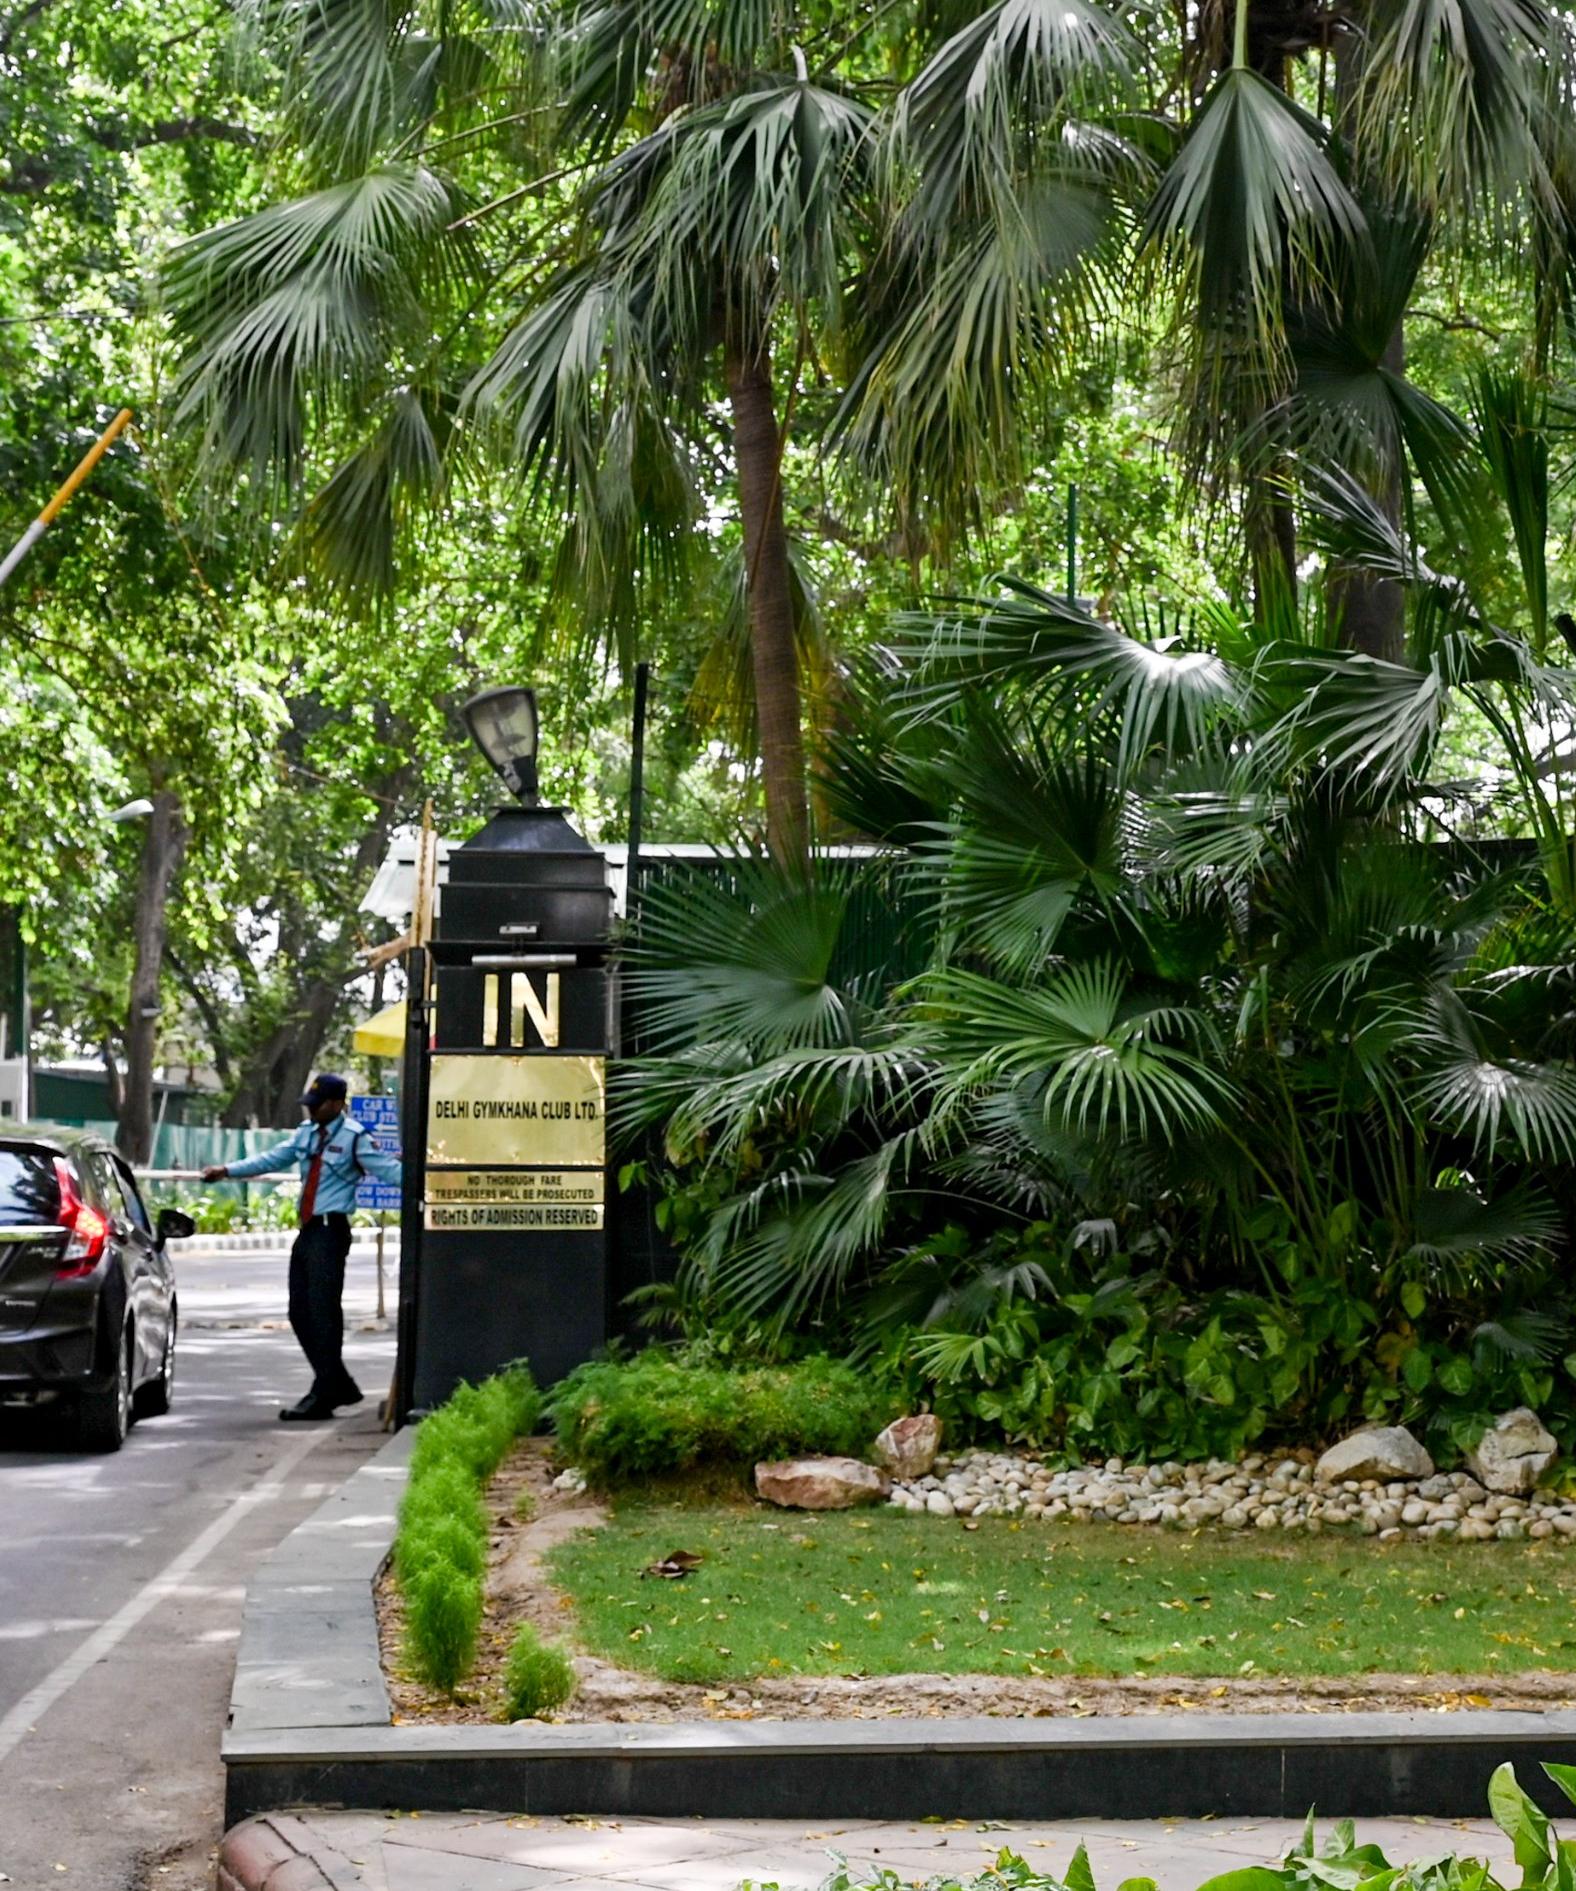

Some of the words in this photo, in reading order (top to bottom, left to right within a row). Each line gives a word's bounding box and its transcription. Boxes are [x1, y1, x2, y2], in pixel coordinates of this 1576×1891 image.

[482, 972, 560, 1047] IN
[436, 1101, 469, 1118] DELHI
[473, 1101, 537, 1119] GYMKHANA
[541, 1102, 571, 1119] CLUB
[467, 1175, 480, 1186] NO
[486, 1175, 535, 1186] THOROUGH
[540, 1175, 562, 1185] FARE
[436, 1189, 497, 1200] TRESPASSERS
[500, 1189, 519, 1200] WILL
[523, 1190, 533, 1200] BE
[537, 1189, 594, 1200] PROSECUTED
[431, 1209, 468, 1225] RIGHTS
[471, 1209, 485, 1225] OF
[487, 1209, 542, 1225] ADMISSION
[545, 1209, 598, 1225] RESERVED
